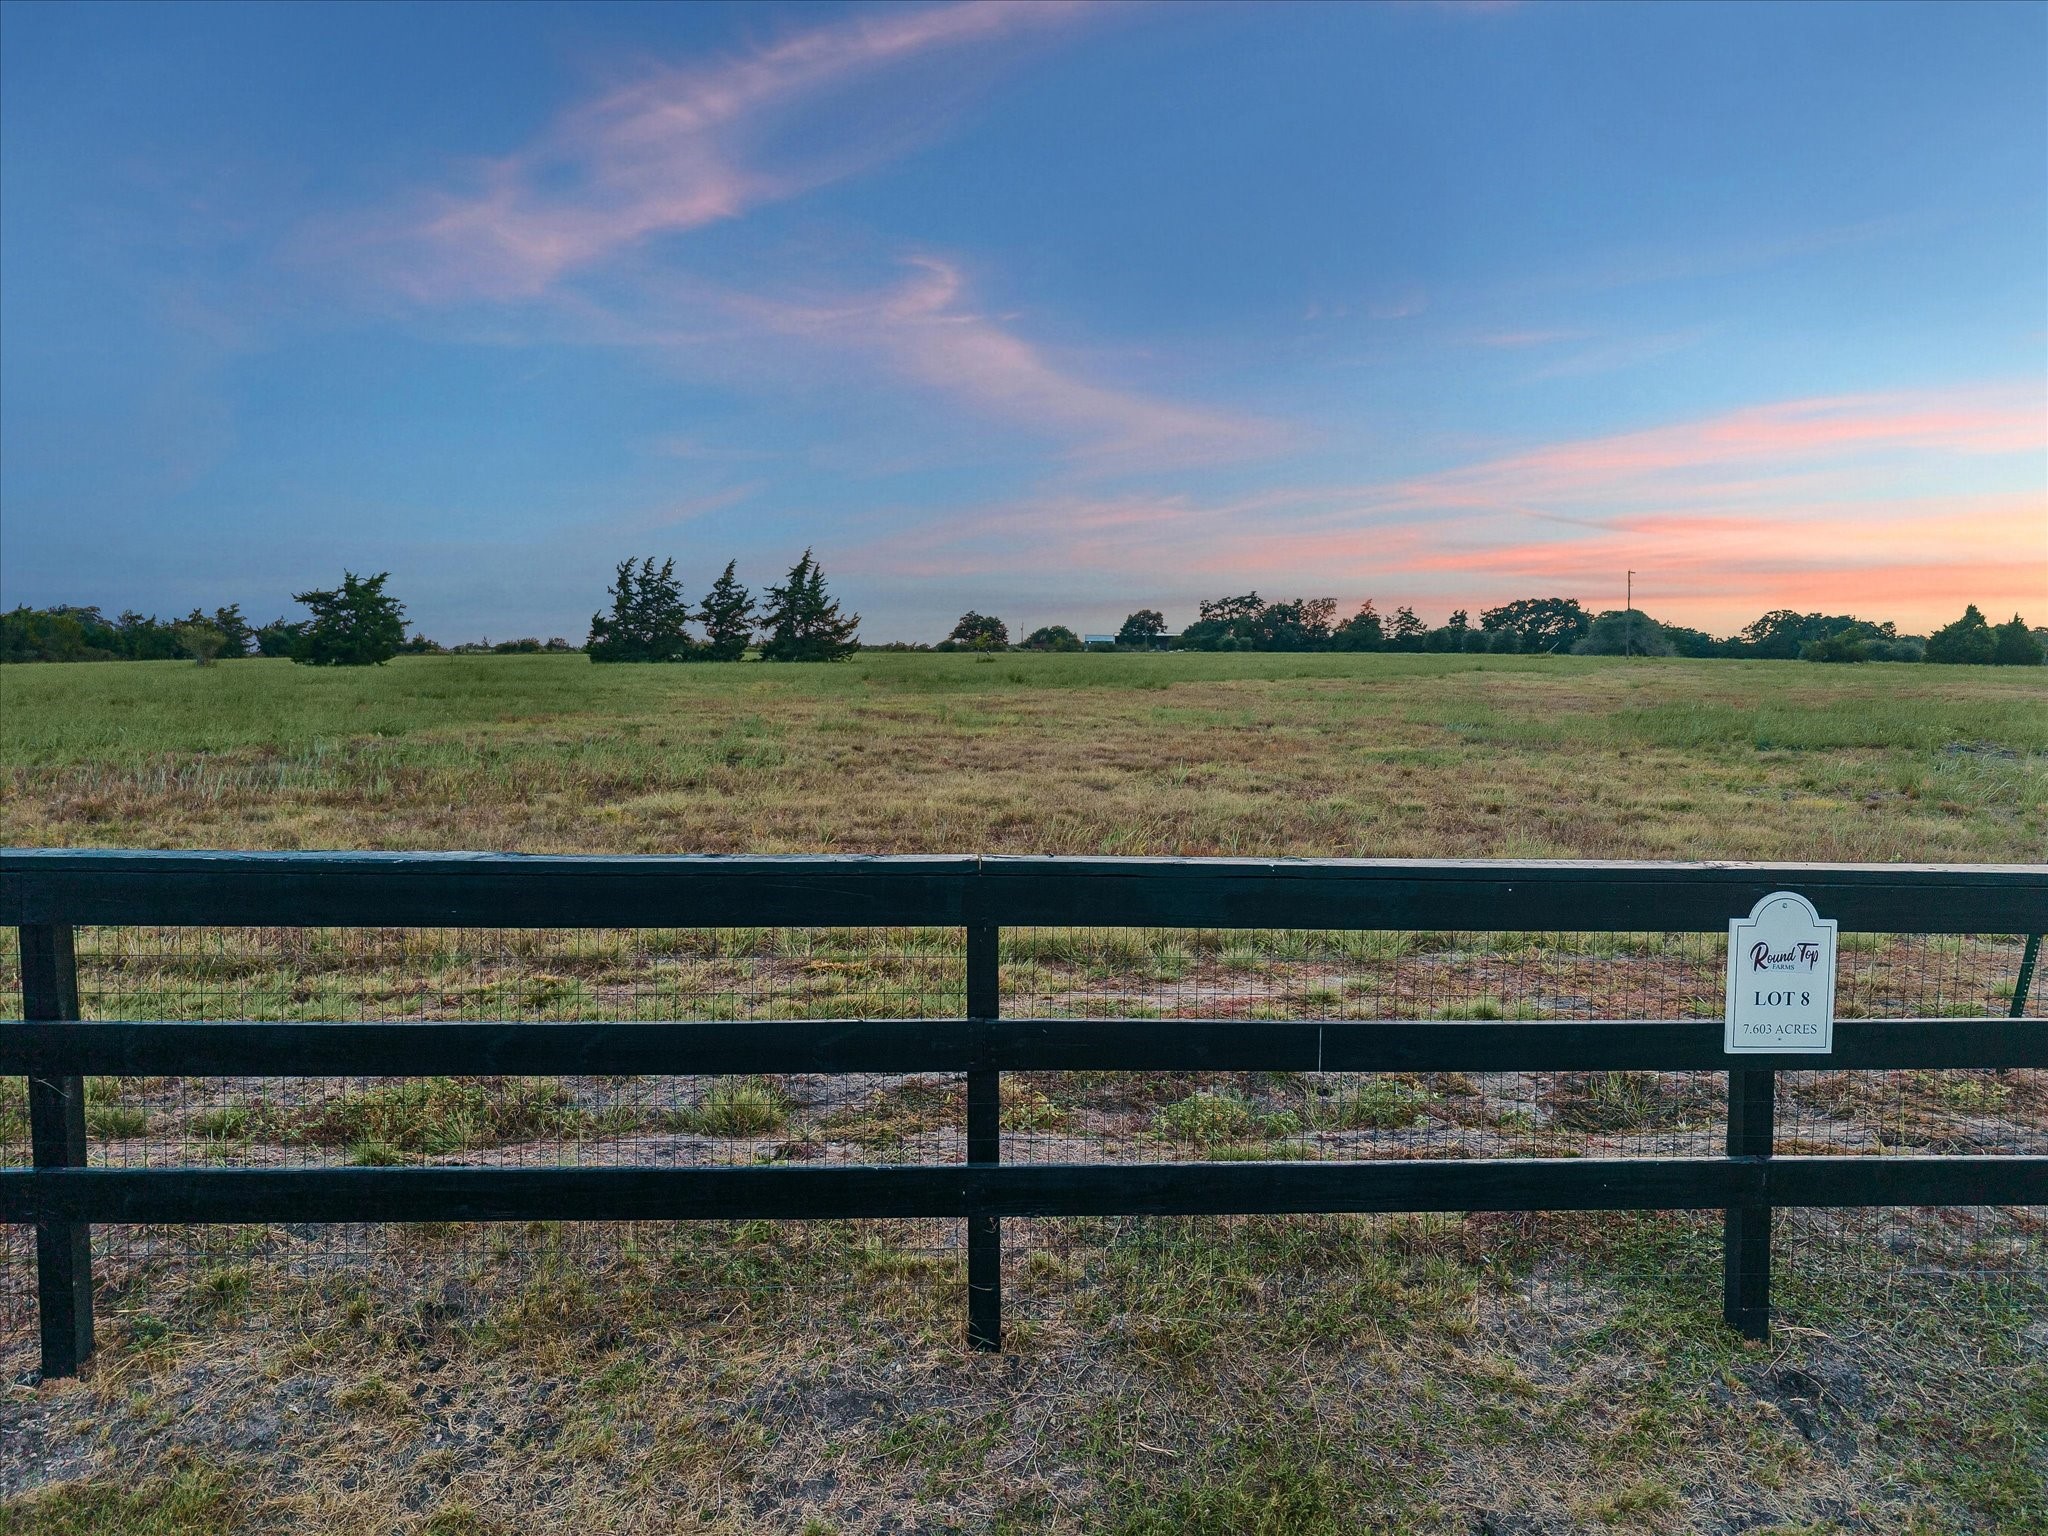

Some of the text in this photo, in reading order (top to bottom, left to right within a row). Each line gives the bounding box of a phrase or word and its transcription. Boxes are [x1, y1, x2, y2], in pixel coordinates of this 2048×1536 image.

[1750, 941, 1819, 972] Round Top
[1754, 991, 1810, 1006] LOT 8
[1743, 1024, 1817, 1034] 7.603 ACRES
